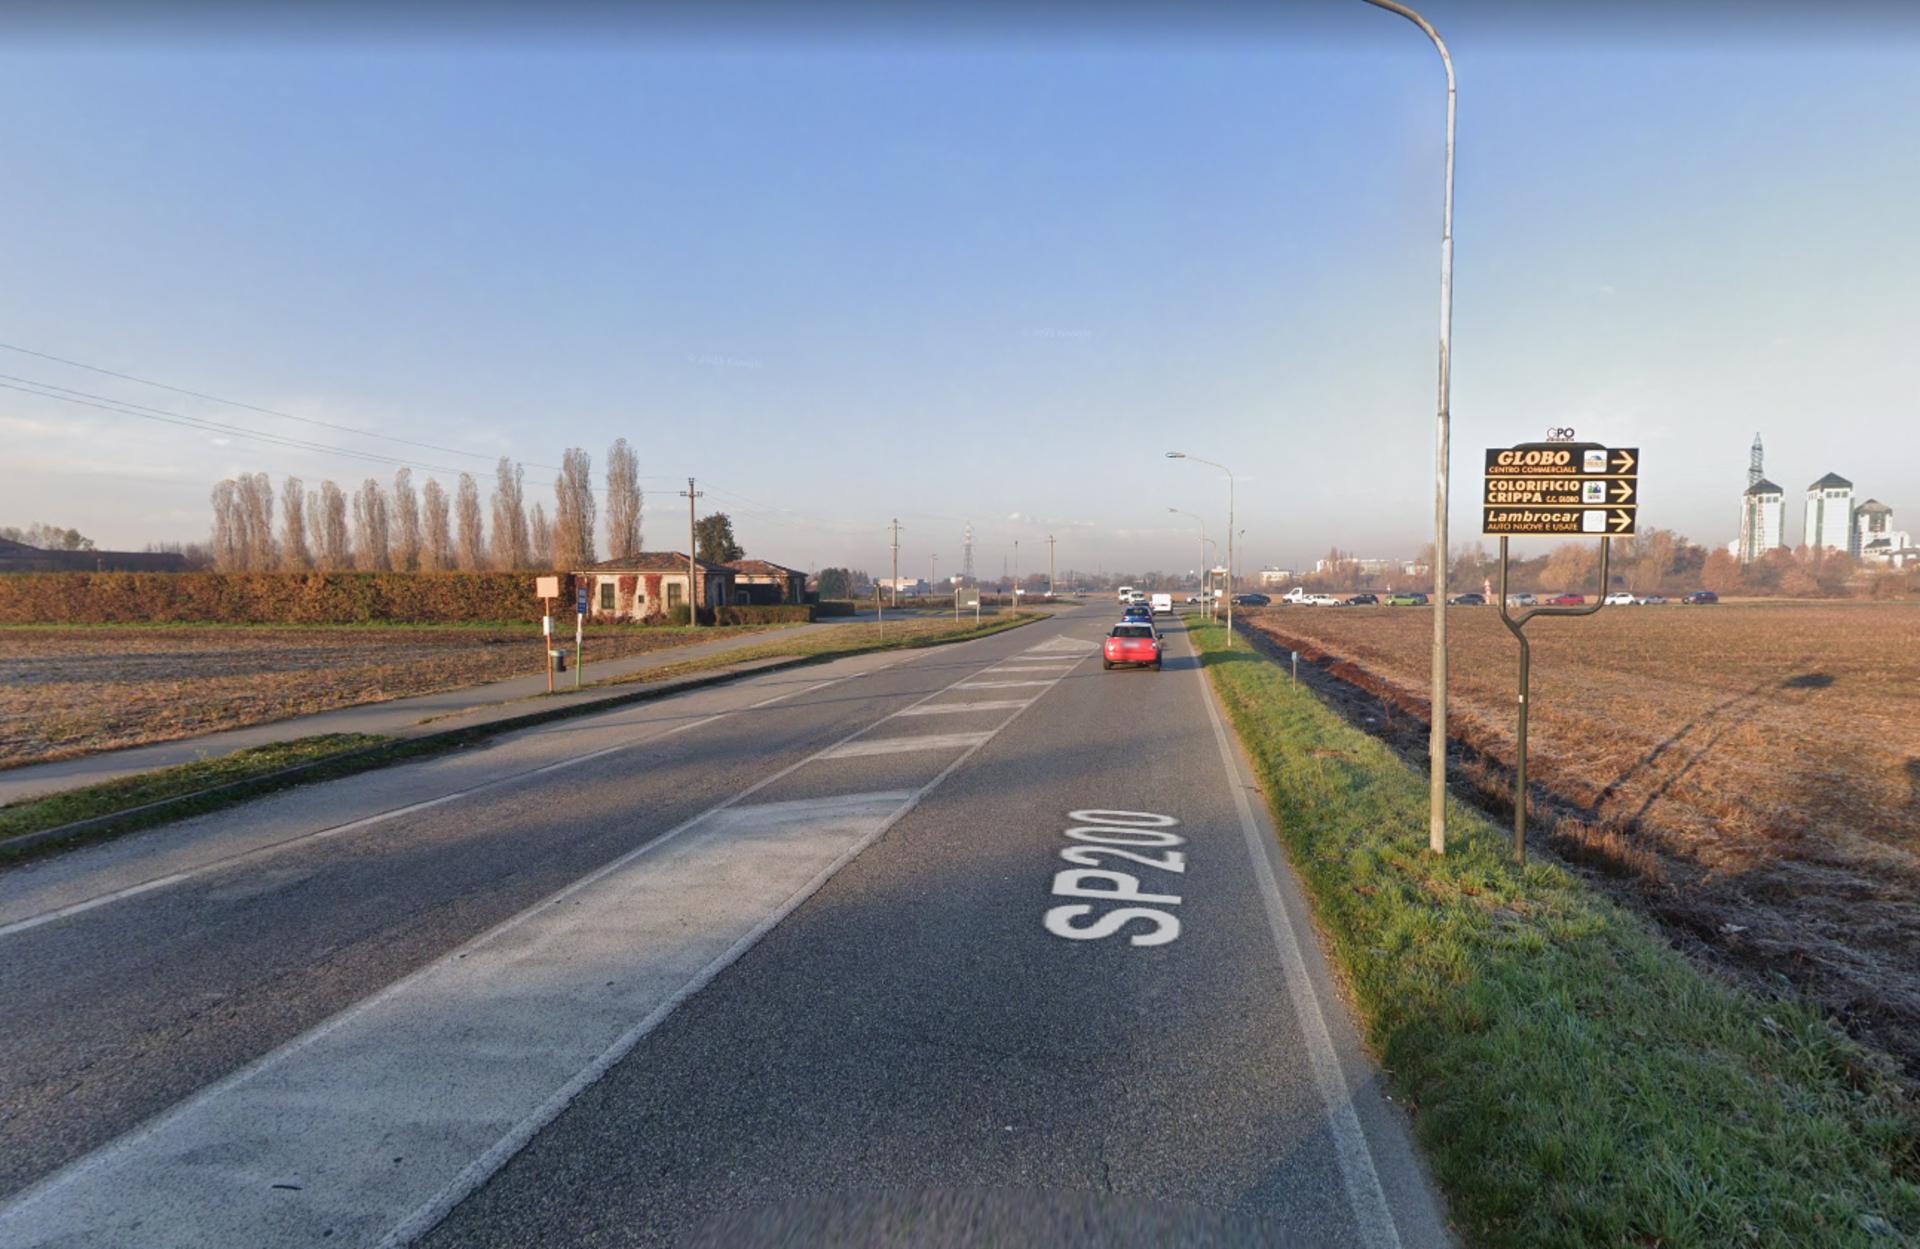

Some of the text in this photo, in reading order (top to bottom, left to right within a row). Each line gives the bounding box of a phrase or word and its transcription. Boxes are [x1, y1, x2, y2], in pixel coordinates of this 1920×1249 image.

[1546, 427, 1575, 438] GPO
[1497, 450, 1571, 466] GLOBO
[1488, 480, 1580, 491] COLORIFICIO
[1487, 492, 1542, 503] CRIPPA
[1558, 495, 1580, 503] GLOBO
[1487, 510, 1580, 522] Lambrocar
